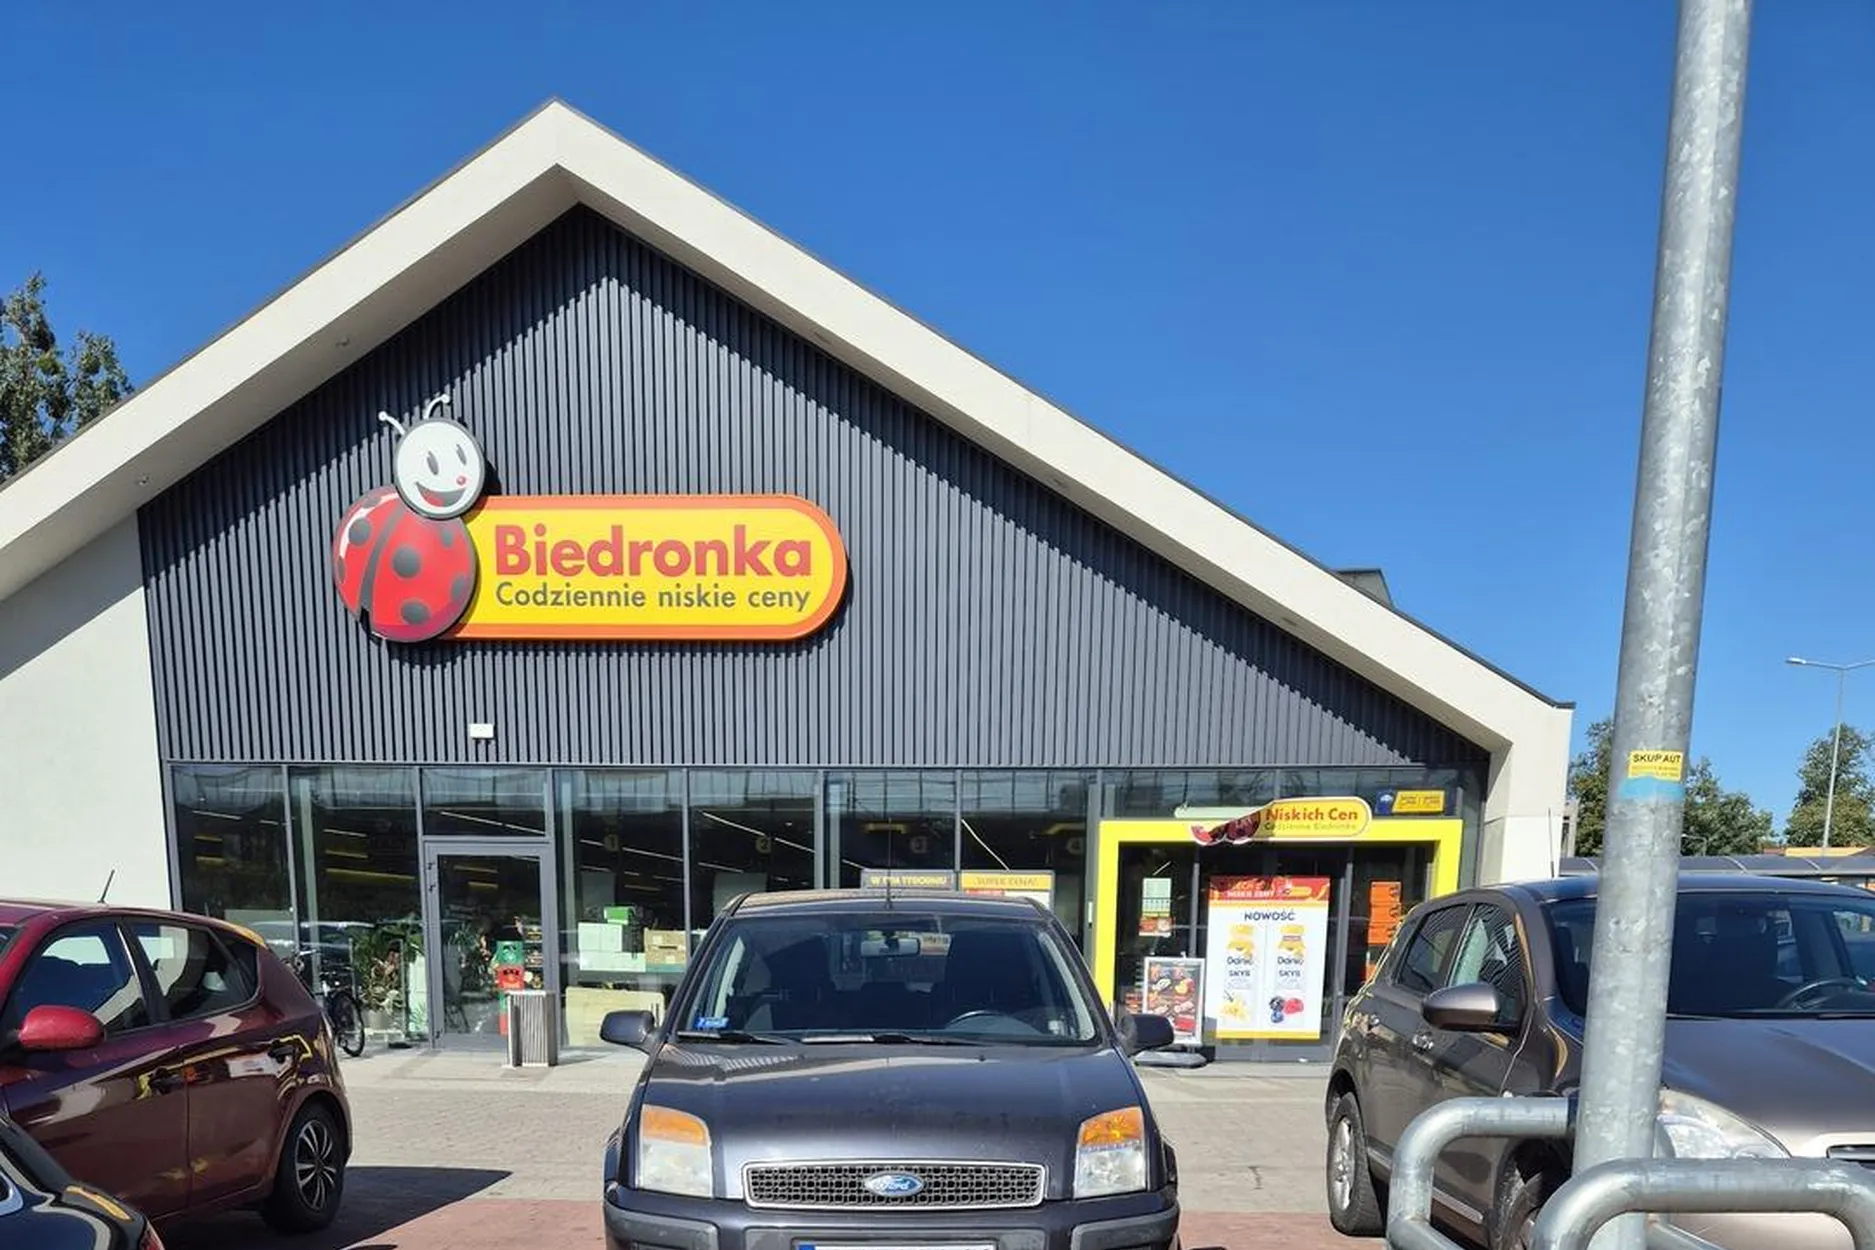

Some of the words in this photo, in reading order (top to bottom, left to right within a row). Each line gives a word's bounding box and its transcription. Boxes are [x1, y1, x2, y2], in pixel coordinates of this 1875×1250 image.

[495, 523, 811, 577] Biedronka
[496, 581, 645, 607] Codziennie
[658, 583, 736, 608] niskie
[749, 590, 810, 612] ceny
[1633, 753, 1662, 763] SKUP
[1265, 807, 1324, 820] Niskich
[1328, 808, 1358, 821] Cen
[1244, 908, 1296, 921] NOWOŚĆ
